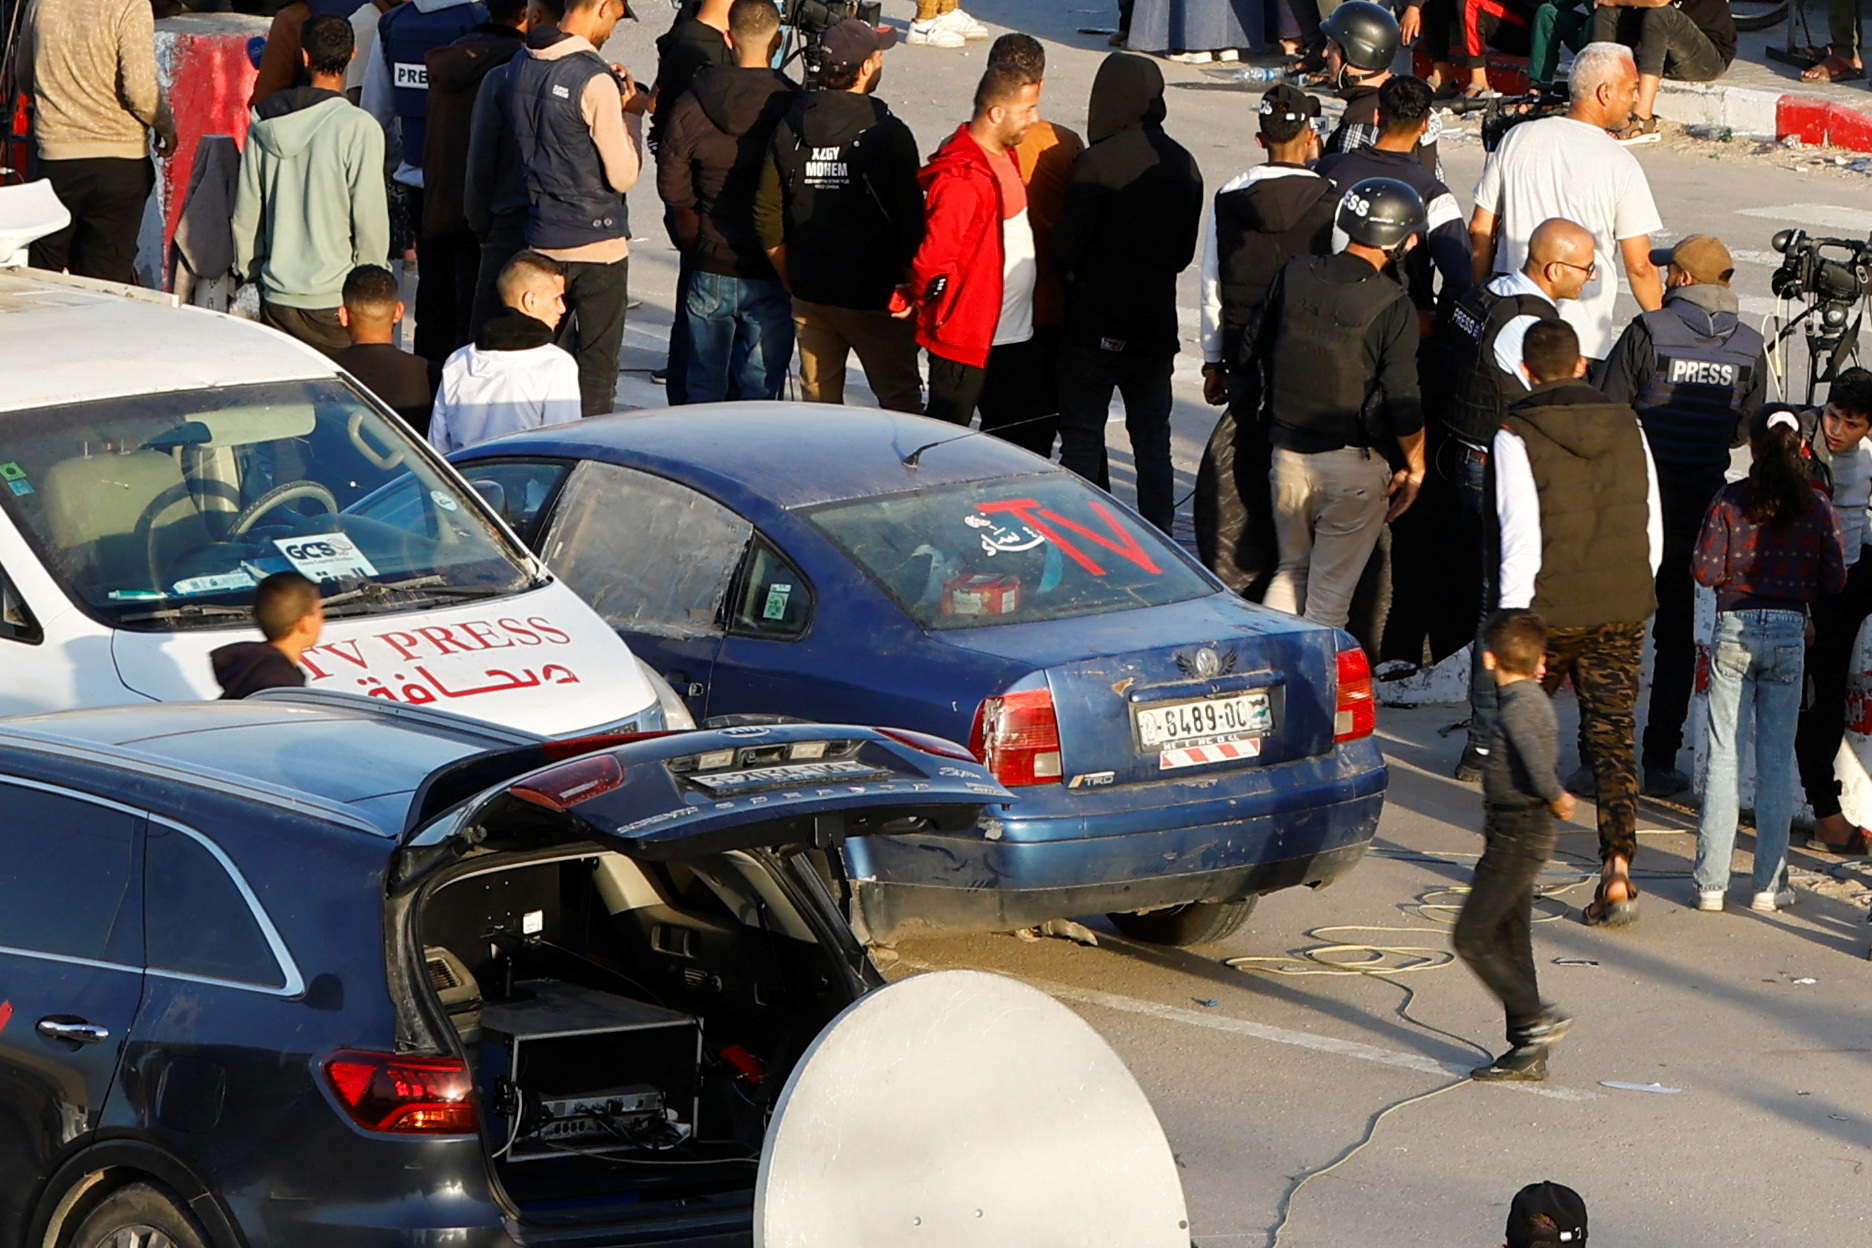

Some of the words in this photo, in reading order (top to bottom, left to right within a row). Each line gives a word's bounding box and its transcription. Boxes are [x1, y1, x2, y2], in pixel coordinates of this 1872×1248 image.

[398, 67, 428, 85] PRE
[1673, 359, 1732, 386] PRESS
[975, 499, 1163, 576] TV
[298, 639, 368, 681] TV
[373, 616, 572, 662] PRESS
